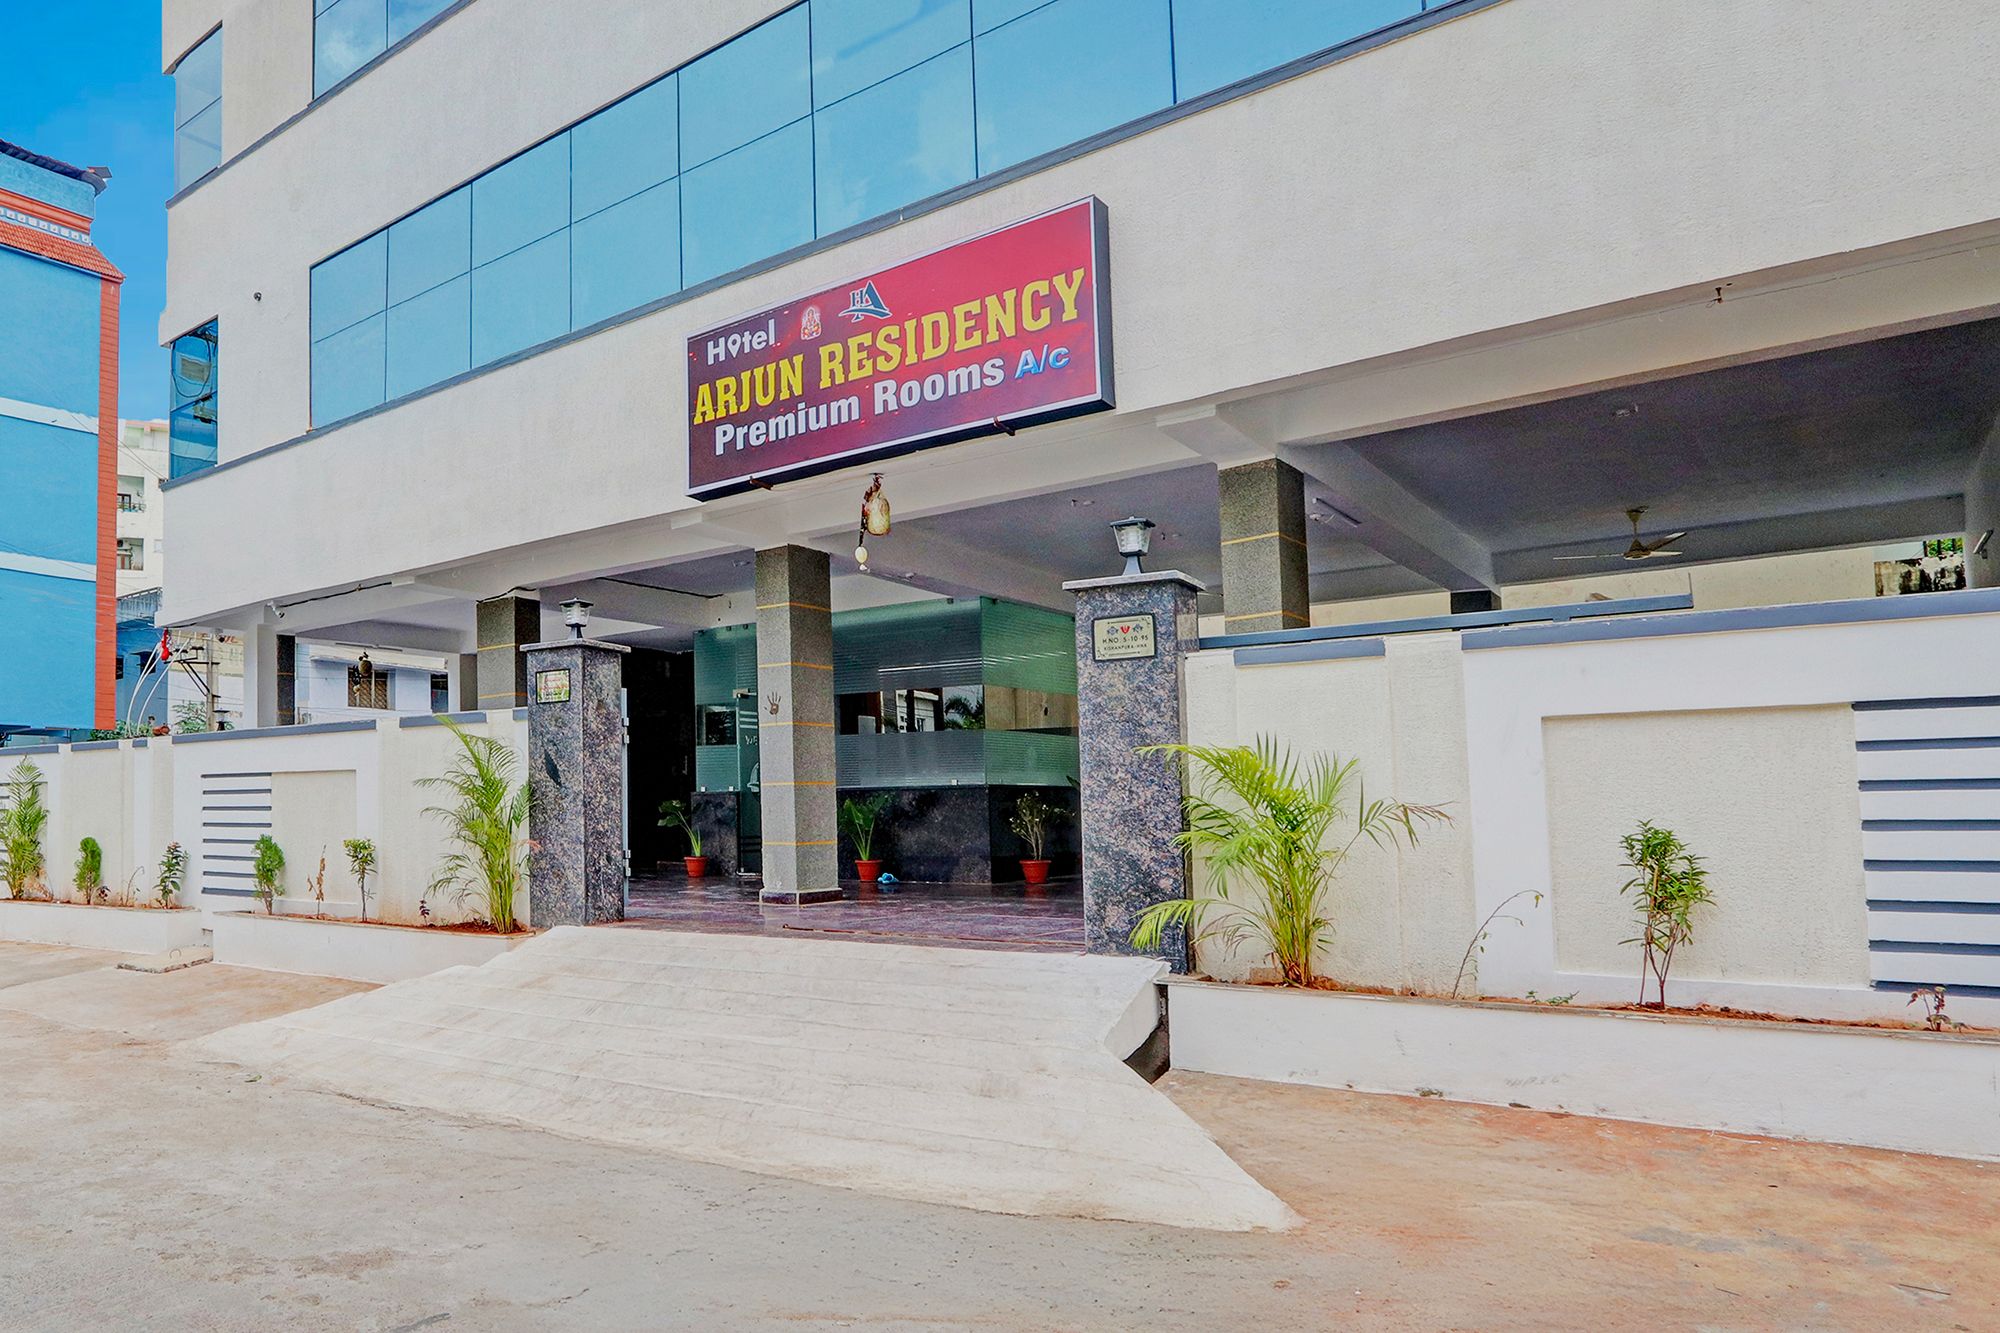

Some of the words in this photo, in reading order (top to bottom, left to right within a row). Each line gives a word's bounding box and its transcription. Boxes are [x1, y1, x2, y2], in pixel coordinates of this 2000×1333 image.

[693, 353, 804, 425] ARJUN
[819, 267, 1086, 389] RESIDENCY
[714, 394, 860, 456] Premium
[873, 357, 1006, 415] Rooms
[1014, 343, 1071, 379] A/c
